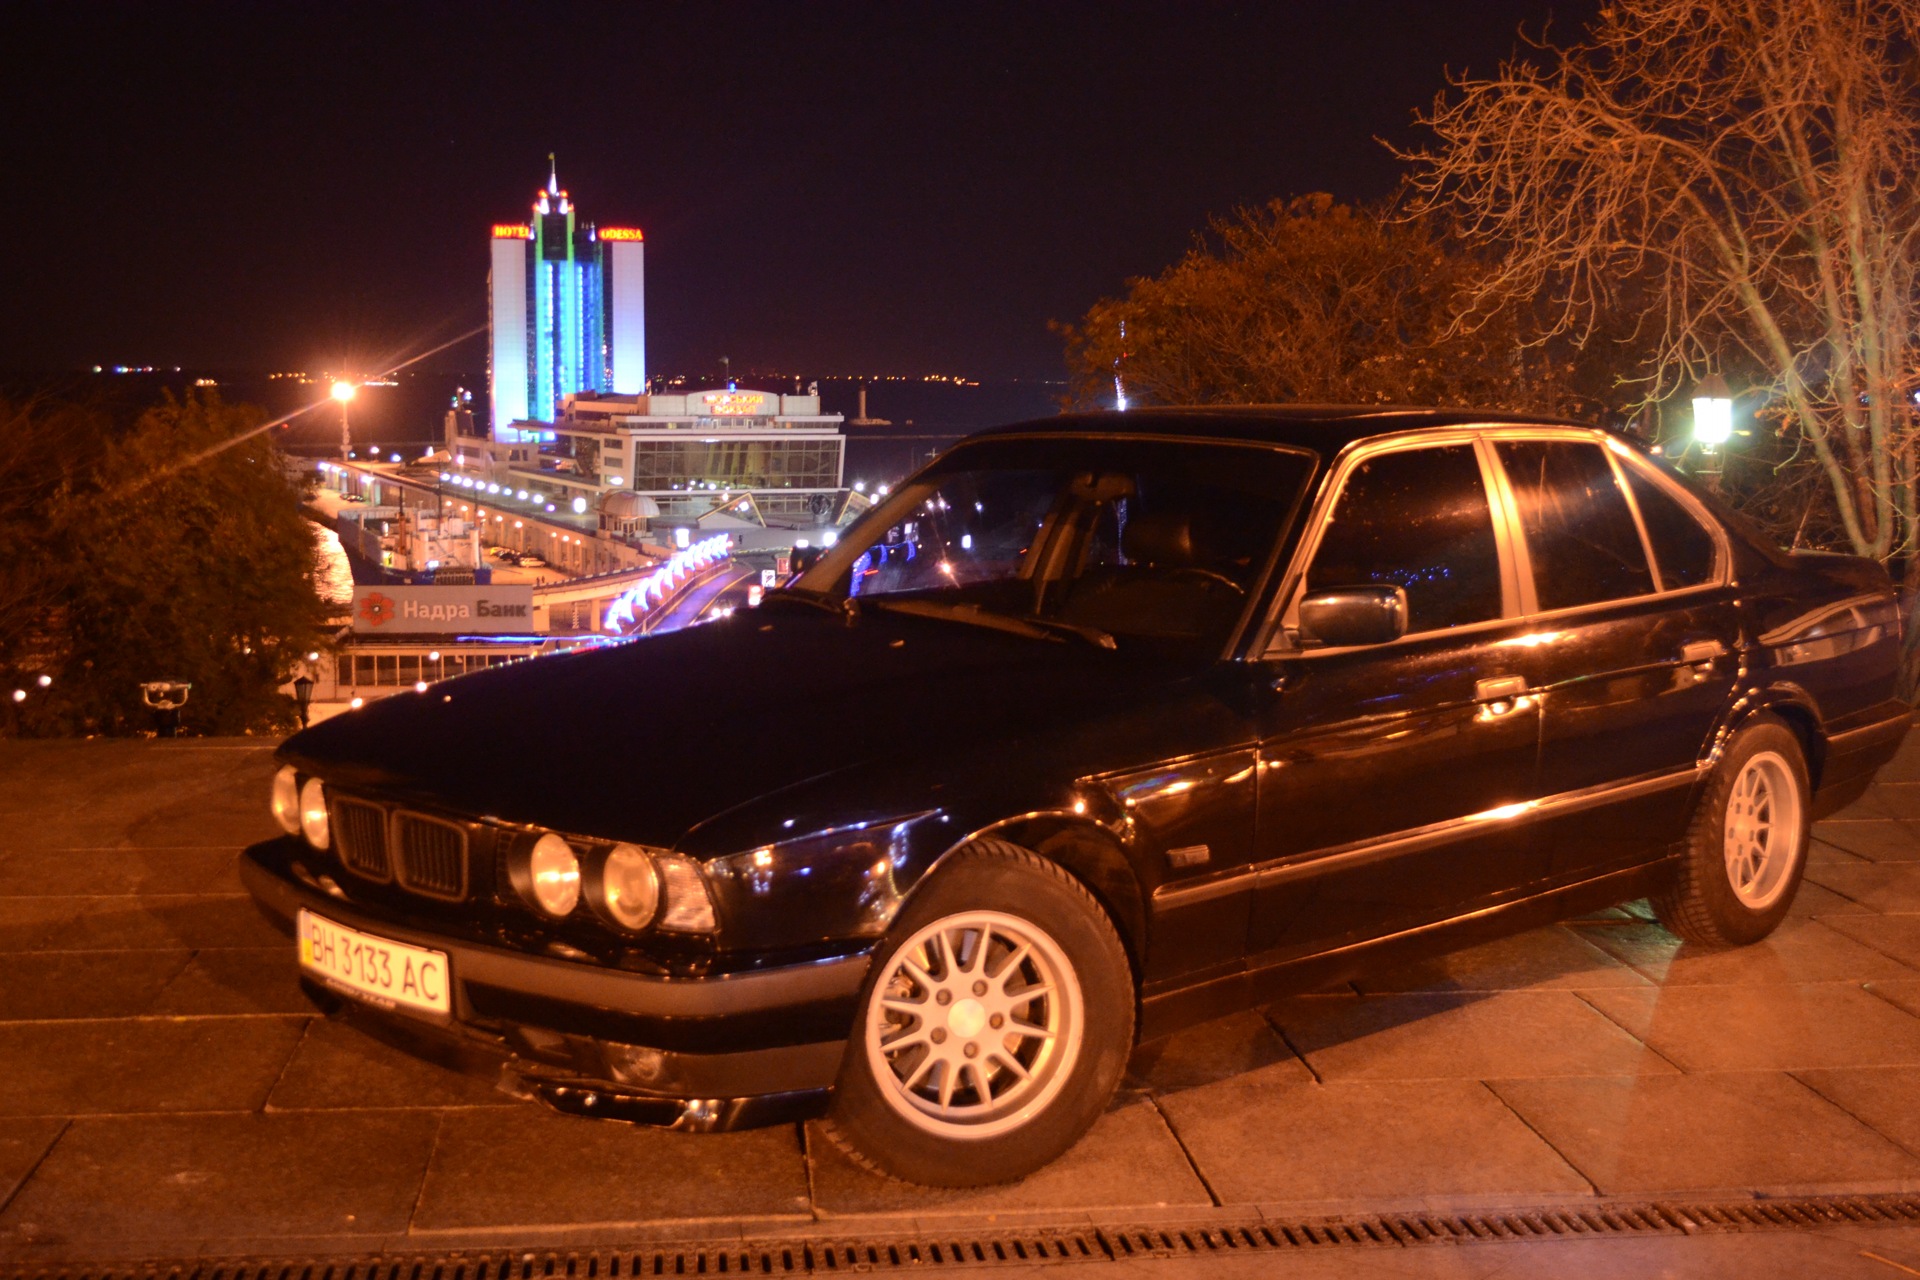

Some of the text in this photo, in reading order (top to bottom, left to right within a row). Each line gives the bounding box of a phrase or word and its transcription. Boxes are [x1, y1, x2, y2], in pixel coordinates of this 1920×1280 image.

[494, 225, 530, 238] HOTEL
[600, 228, 643, 240] ODESSA
[403, 600, 527, 621] Надра Банк
[312, 925, 336, 970] BH
[341, 938, 393, 988] 3133
[402, 956, 439, 1001] AC
